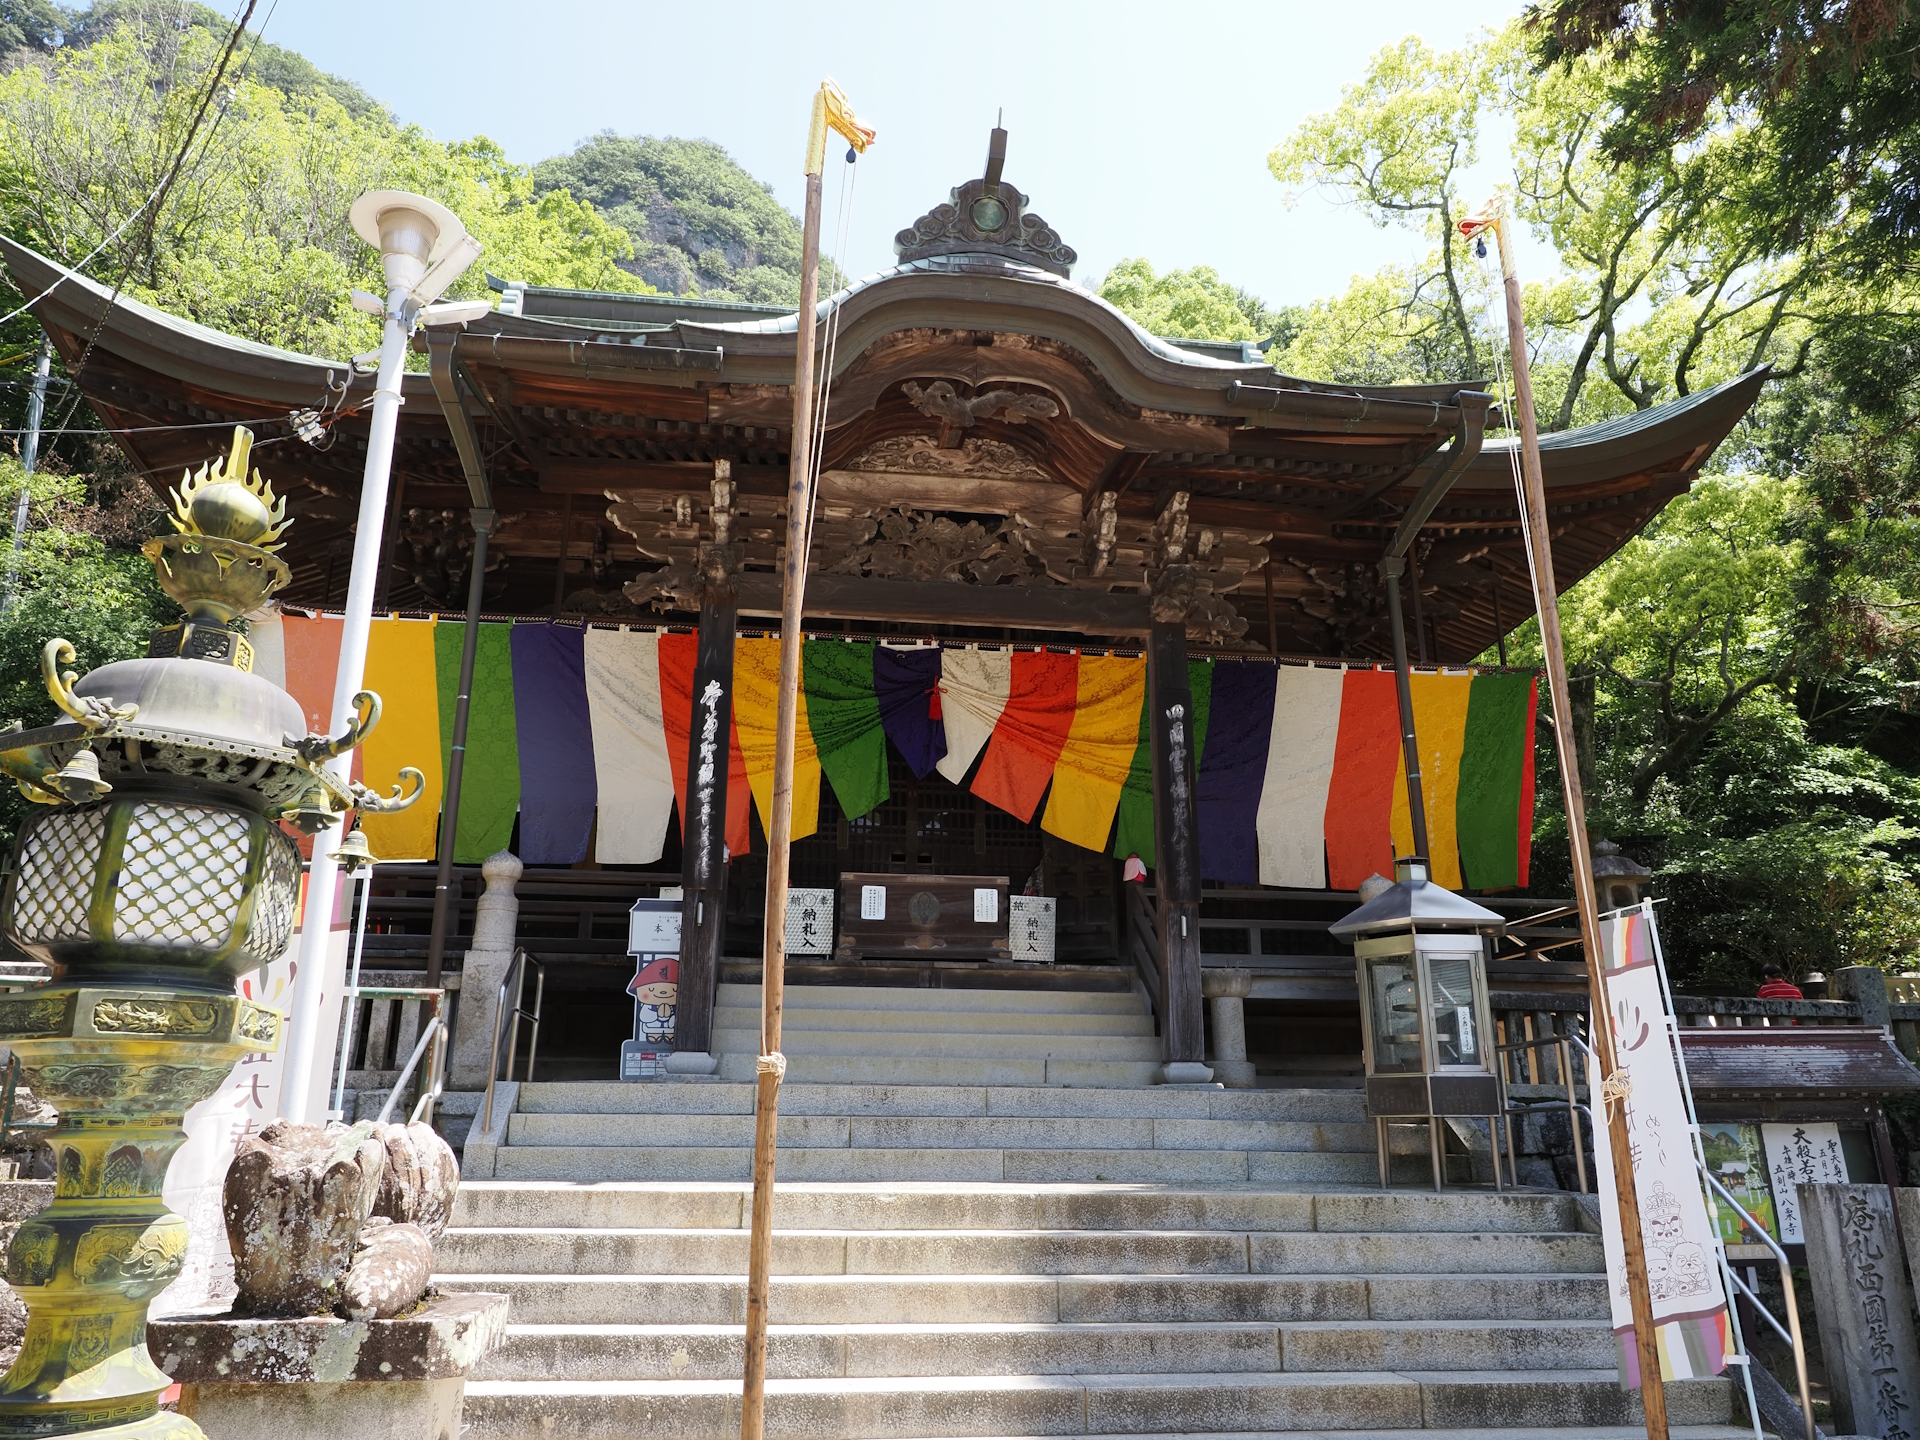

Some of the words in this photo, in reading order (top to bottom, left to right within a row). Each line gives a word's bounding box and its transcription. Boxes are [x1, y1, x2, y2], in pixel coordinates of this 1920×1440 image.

[790, 894, 801, 906] 納
[1012, 900, 1024, 911] 納
[653, 923, 682, 935] 本堂
[801, 908, 817, 948] 納札入
[1026, 917, 1039, 952] 納札入
[1819, 1148, 1831, 1183] 五月十
[1781, 1198, 1797, 1235] 八栗寺
